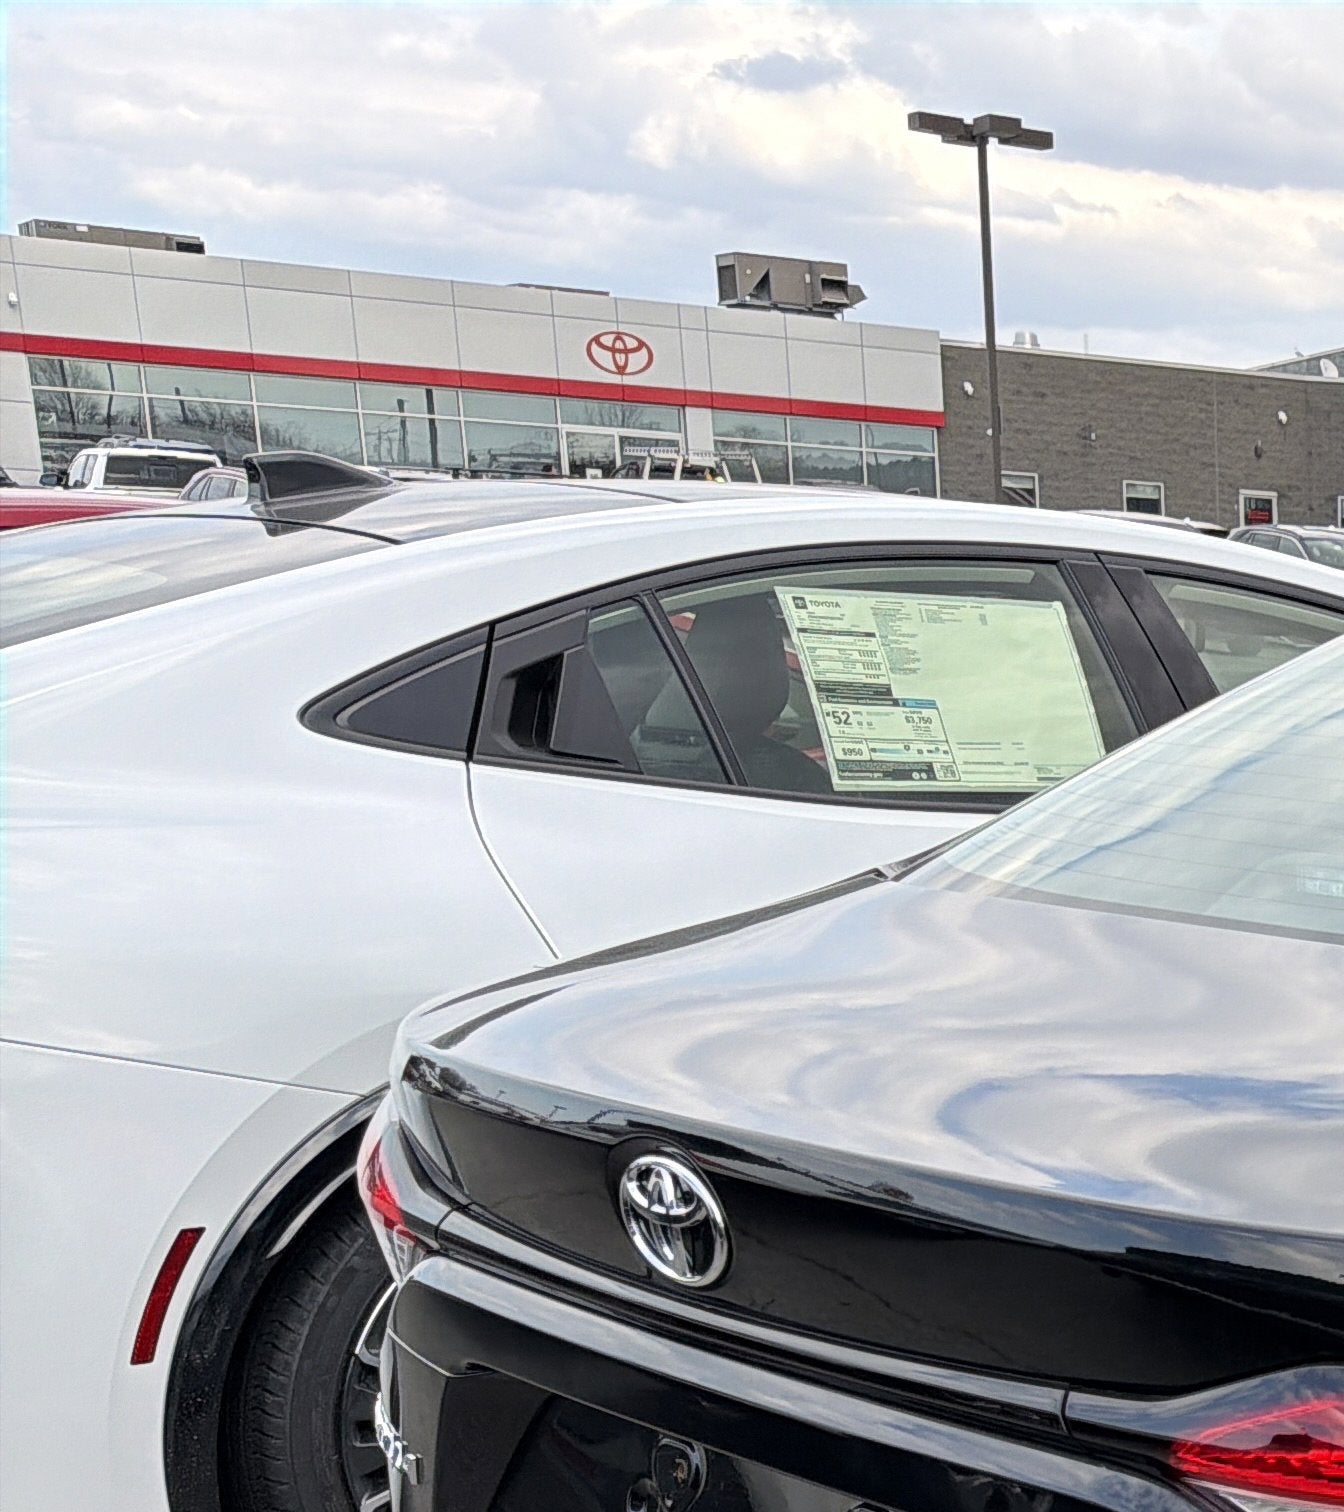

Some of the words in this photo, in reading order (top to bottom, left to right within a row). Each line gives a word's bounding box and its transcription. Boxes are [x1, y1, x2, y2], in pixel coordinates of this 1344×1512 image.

[808, 600, 842, 609] TOYOTA
[831, 710, 853, 726] 52
[841, 747, 864, 757] $950
